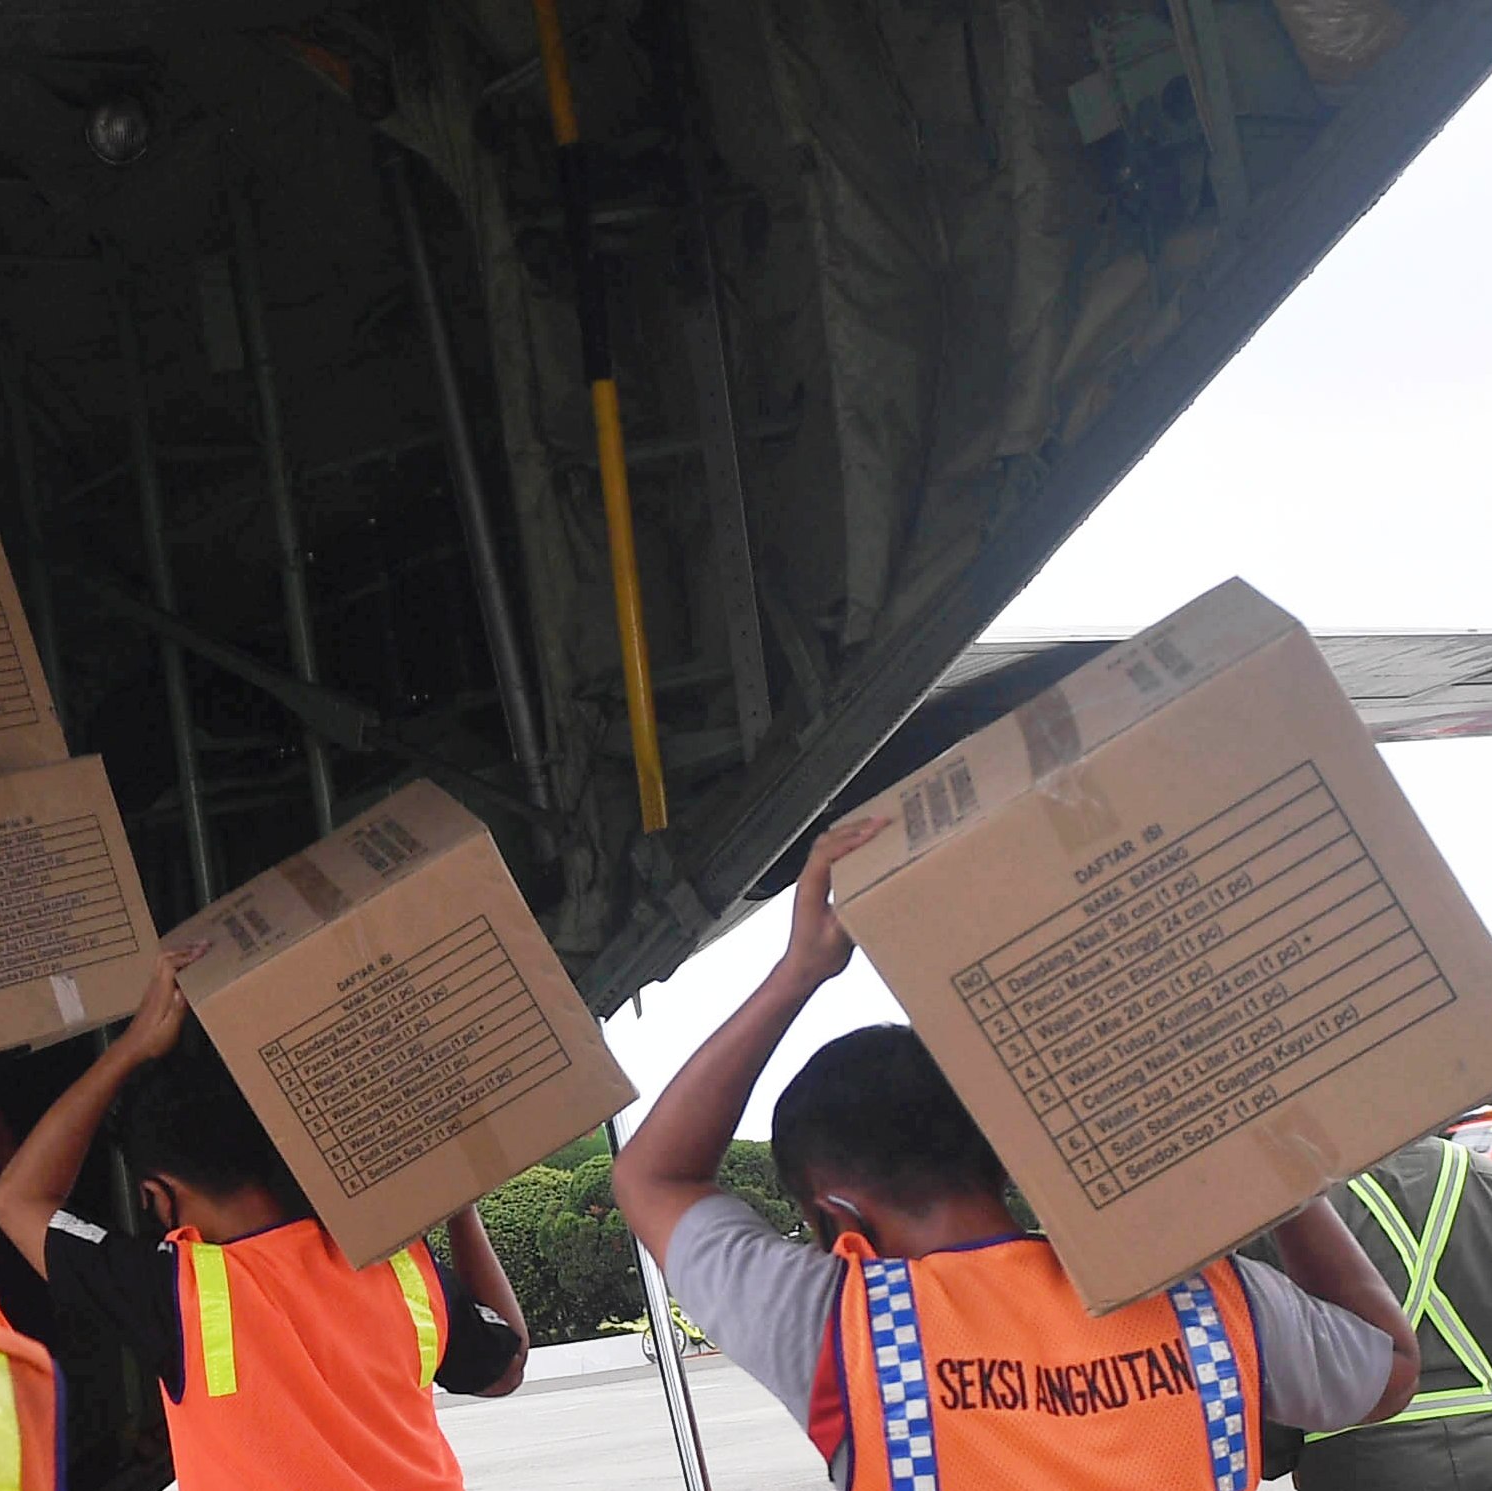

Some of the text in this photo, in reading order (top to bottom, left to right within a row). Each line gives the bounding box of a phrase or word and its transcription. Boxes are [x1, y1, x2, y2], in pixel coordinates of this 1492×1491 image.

[958, 845, 1189, 991] NO NAMA BARANG
[1072, 839, 1137, 885] DAFTAR
[977, 995, 995, 1010] 1.
[1006, 948, 1076, 993] Dandang
[1072, 924, 1109, 953] Nasi
[1108, 911, 1130, 932] 30
[1130, 899, 1155, 920] cm
[1172, 869, 1202, 898] pc)
[992, 1017, 1010, 1034] 2.
[1021, 982, 1066, 1016] Panci
[1063, 953, 1113, 991] Masak
[1112, 924, 1162, 962] Tinggi
[1159, 912, 1183, 933] 24
[1183, 900, 1208, 921] cm
[1225, 870, 1255, 898] pc)
[1007, 1041, 1025, 1057] 3.
[1036, 1007, 1084, 1040] Wajan
[1081, 992, 1104, 1012] 35
[1104, 979, 1130, 1000] cm
[1196, 920, 1225, 948] pc)
[1022, 1064, 1040, 1081] 4.
[1051, 1029, 1096, 1063] Panci
[1093, 1016, 1123, 1038] Mie
[1121, 1000, 1144, 1021] 20
[1144, 988, 1170, 1009] cm
[1186, 959, 1215, 987] pc)
[1037, 1088, 1055, 1104] 5.
[1113, 1028, 1160, 1059] Tutup
[1155, 995, 1215, 1033] Kuning
[1210, 980, 1233, 1001] 24
[1232, 968, 1258, 989] cm
[1275, 938, 1305, 967] pc)
[1066, 1135, 1084, 1151] 6.
[1095, 1102, 1141, 1134] Water
[1139, 1084, 1173, 1108] Jug
[1170, 1066, 1196, 1089] 1.5
[1193, 1049, 1231, 1075] Liter
[1248, 1015, 1285, 1047] pcs)
[1080, 1067, 1147, 1110] Centong
[1143, 1044, 1180, 1073] Nasi
[1260, 979, 1290, 1008] pc)
[1081, 1157, 1099, 1174] 7.
[1212, 1055, 1277, 1096] Gagang
[1272, 1031, 1315, 1061] Kayu
[1330, 1002, 1361, 1031] pc)
[1124, 1138, 1183, 1180] Sendok
[1181, 1122, 1217, 1147] Sop
[1250, 1082, 1279, 1110] pc)
[936, 1338, 1195, 1416] SEKSI ANGKUTAN
